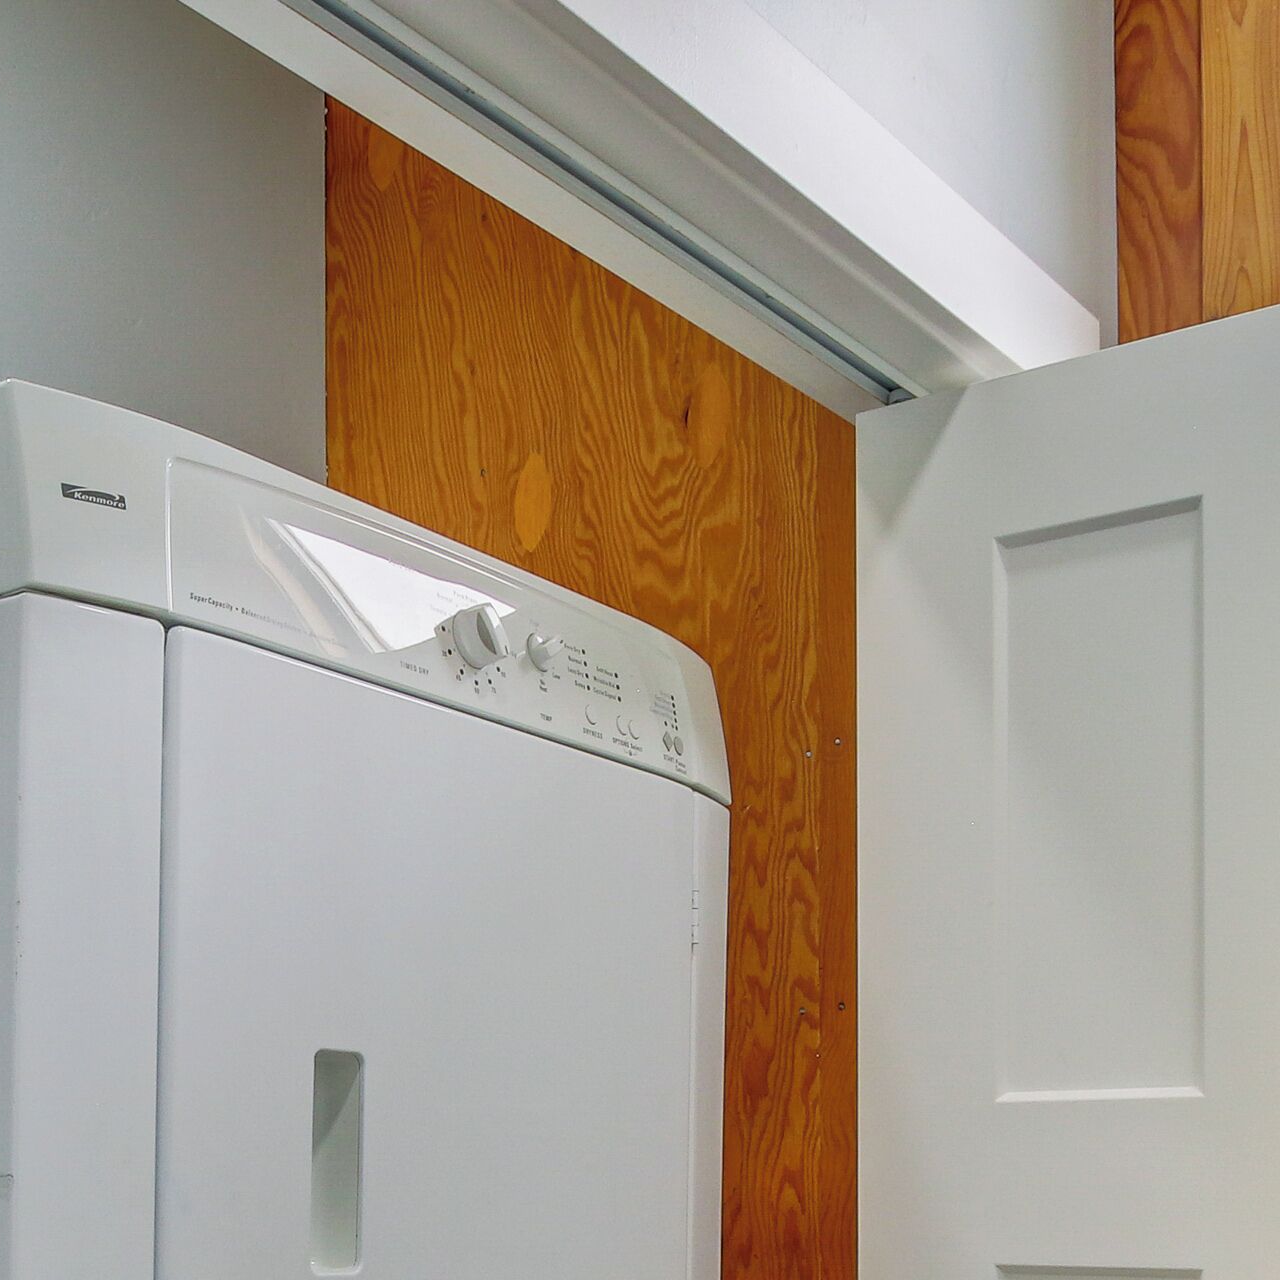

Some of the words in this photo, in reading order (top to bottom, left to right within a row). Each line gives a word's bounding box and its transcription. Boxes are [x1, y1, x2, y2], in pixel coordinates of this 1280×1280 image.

[72, 490, 125, 509] Kenmore
[400, 660, 417, 673] TIMED
[419, 666, 430, 675] DRY
[583, 727, 603, 740] DRYNESS
